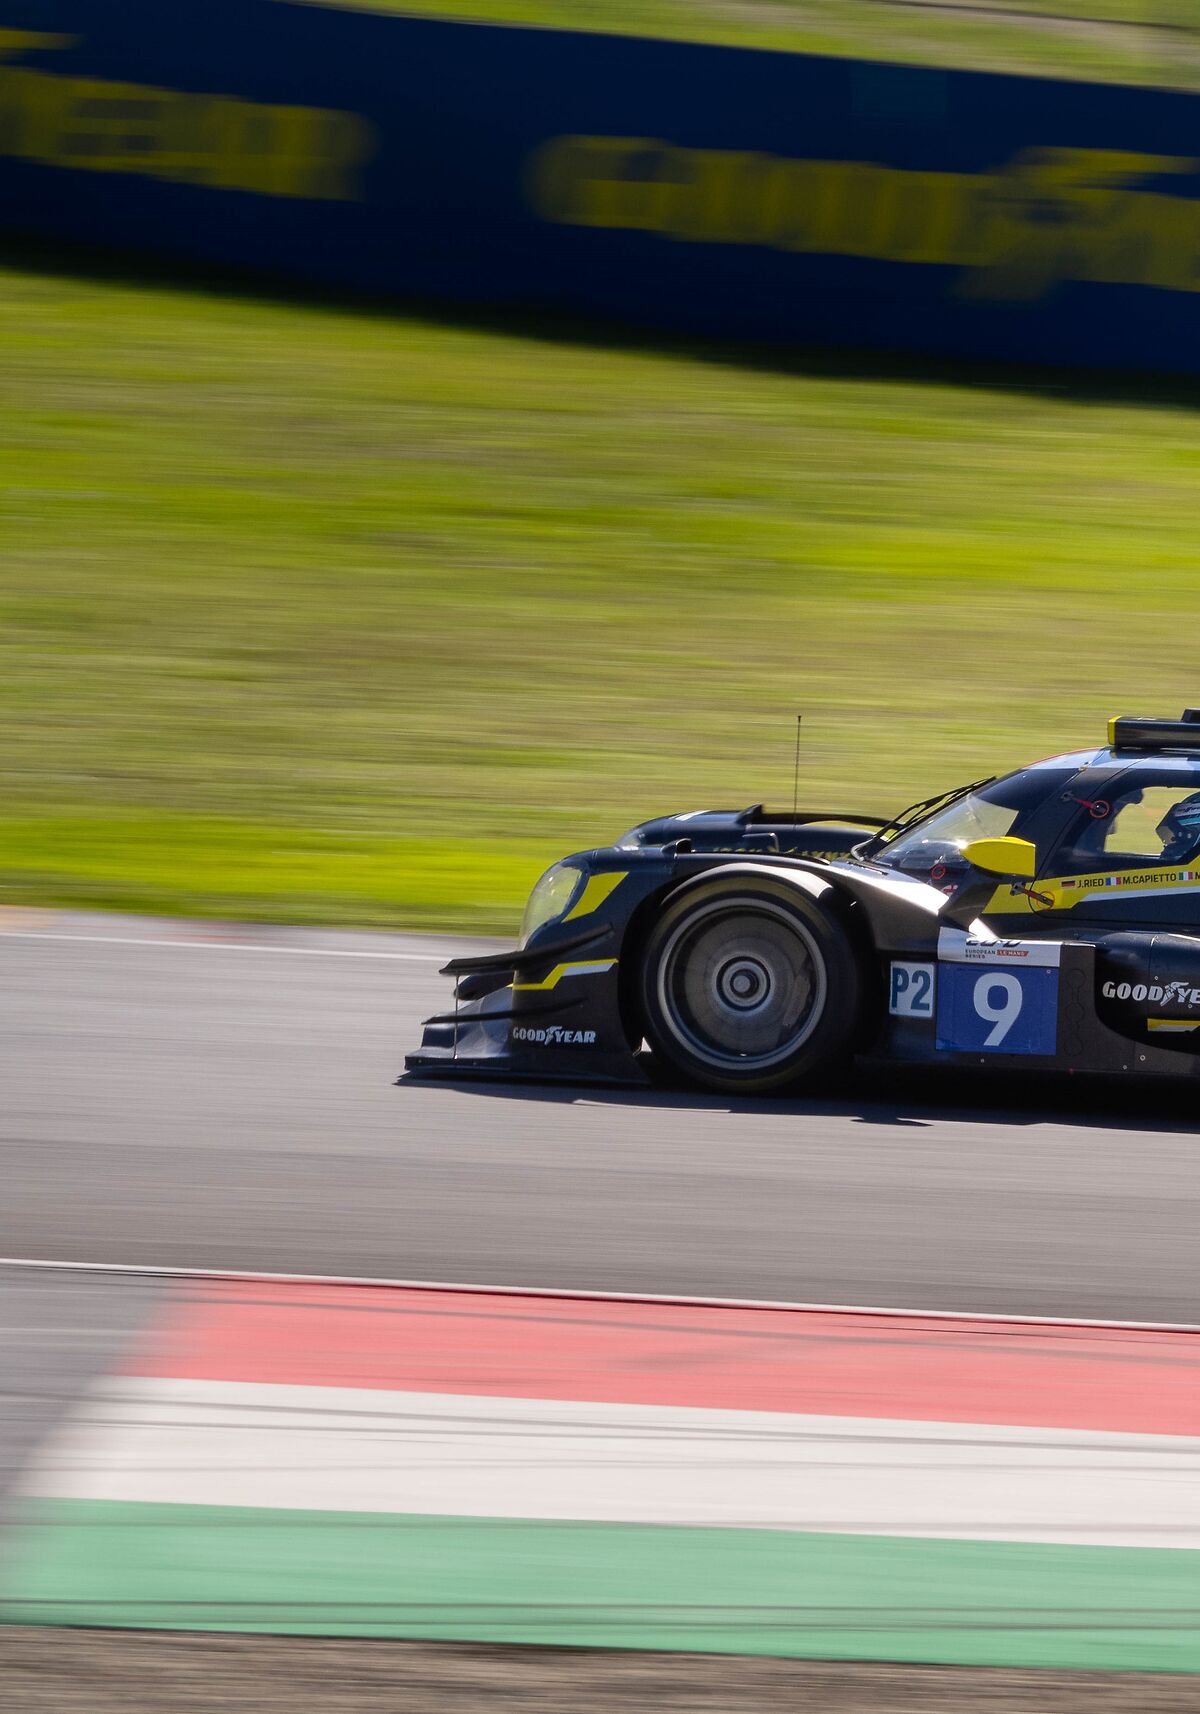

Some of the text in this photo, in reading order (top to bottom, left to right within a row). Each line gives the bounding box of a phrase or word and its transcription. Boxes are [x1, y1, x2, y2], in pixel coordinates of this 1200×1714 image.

[1122, 873, 1177, 885] M.CAPIETTO
[891, 967, 931, 1011] P2
[973, 972, 1023, 1047] 9
[512, 1025, 596, 1046] GOODYEAR
